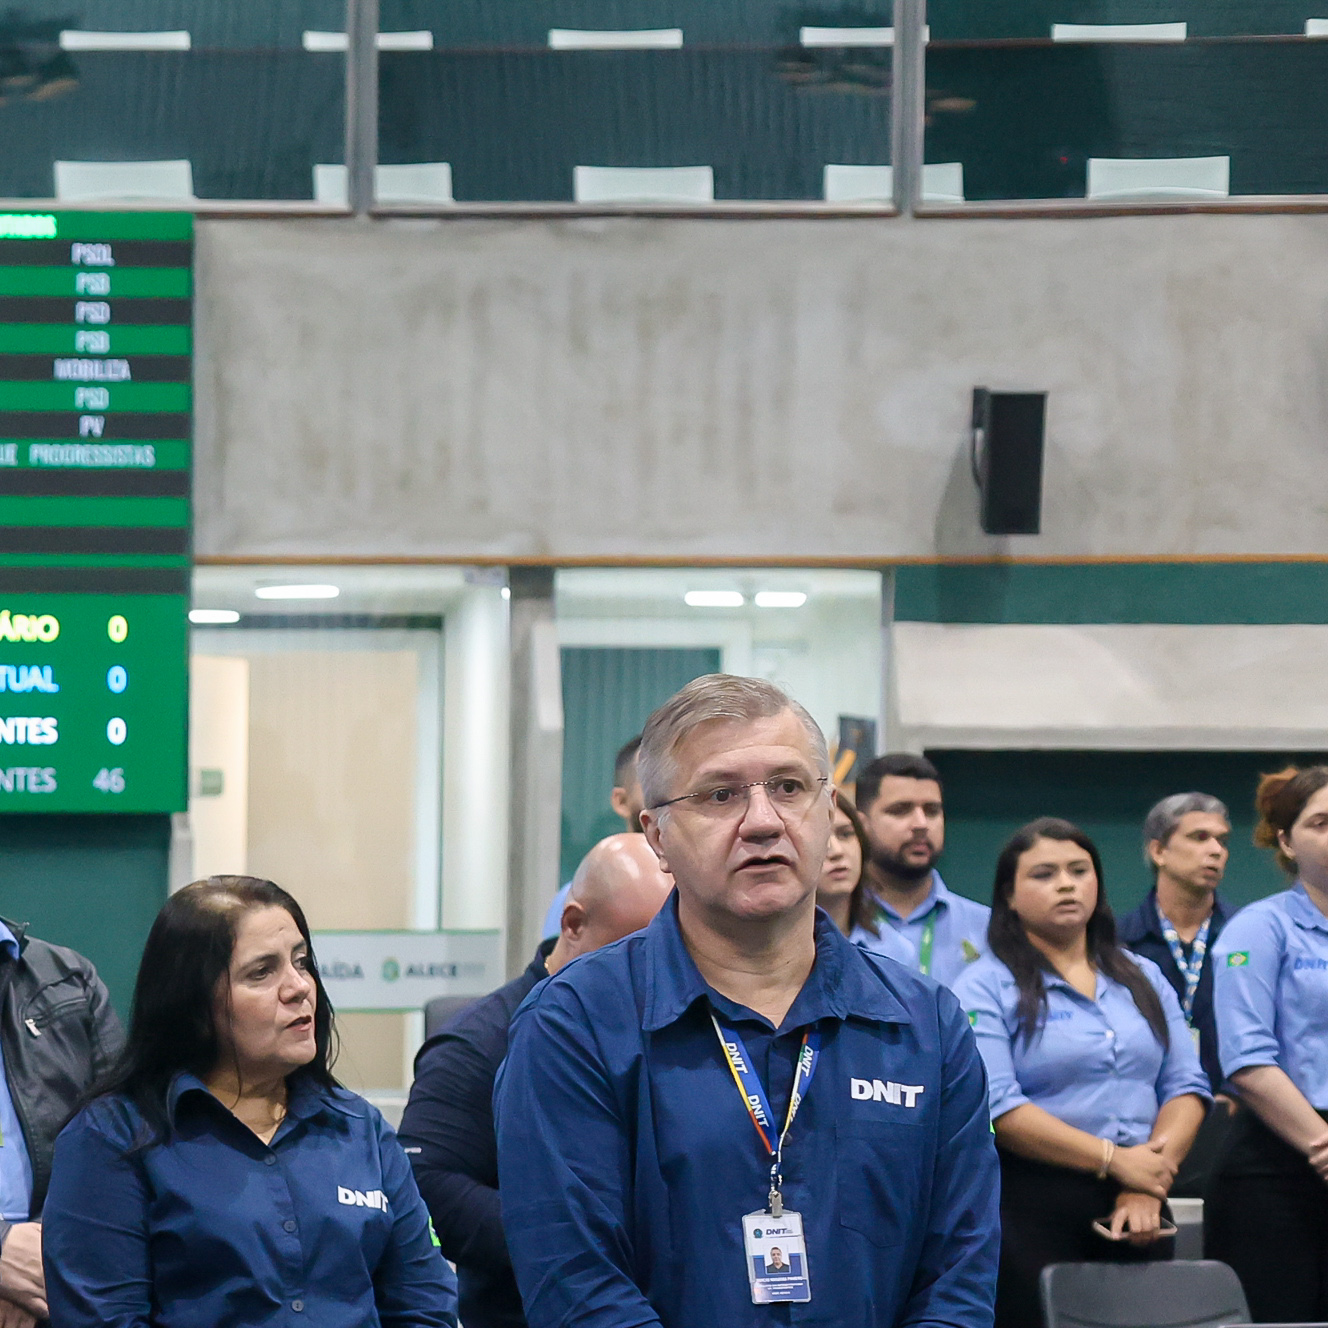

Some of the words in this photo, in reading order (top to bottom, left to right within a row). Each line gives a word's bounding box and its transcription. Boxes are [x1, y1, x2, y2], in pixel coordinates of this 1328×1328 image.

[107, 615, 128, 643] 0
[106, 665, 128, 693] 0
[106, 717, 127, 745] 0
[93, 768, 125, 793] 46
[320, 960, 364, 979] AÍDA
[725, 1042, 748, 1074] DNIT
[801, 1045, 813, 1077] DNIT
[851, 1077, 924, 1108] DNIT
[747, 1094, 769, 1127] DNIT
[337, 1185, 390, 1213] DNIT
